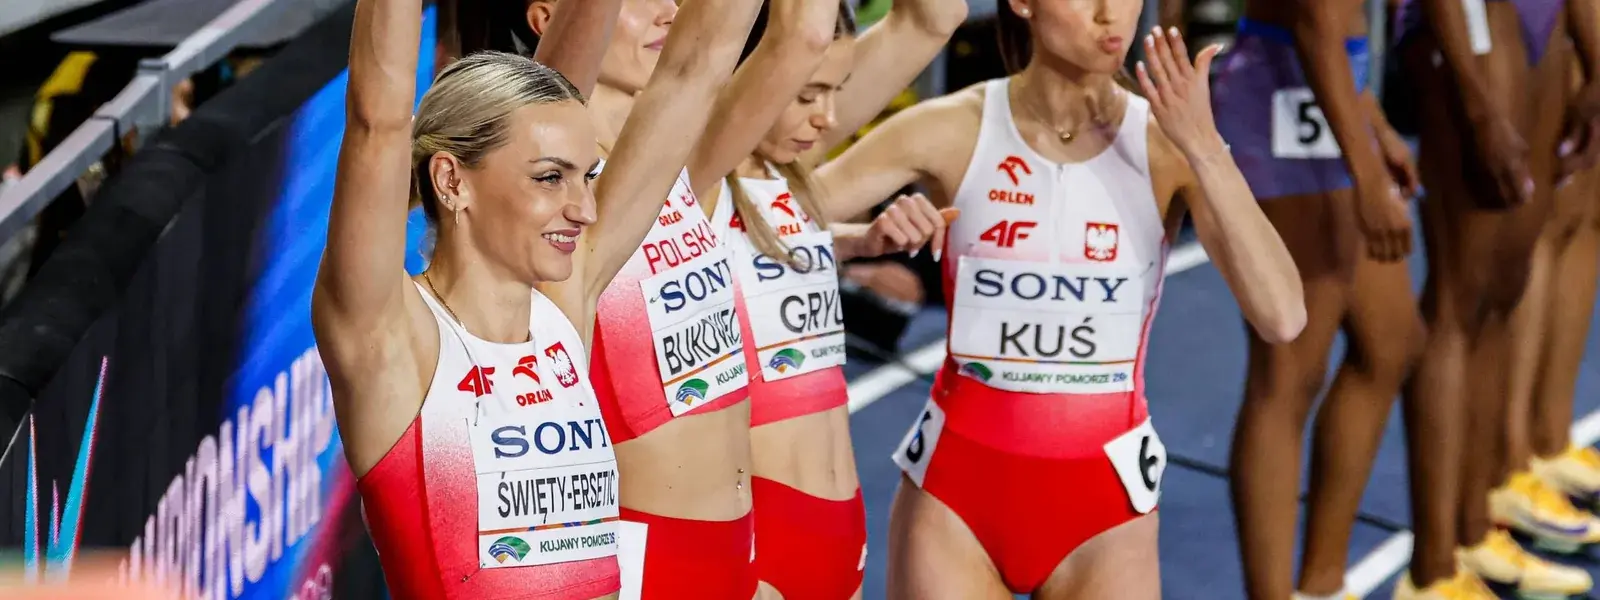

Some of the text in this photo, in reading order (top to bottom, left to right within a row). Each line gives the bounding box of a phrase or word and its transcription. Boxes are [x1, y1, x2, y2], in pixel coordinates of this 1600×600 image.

[1298, 102, 1321, 143] 5
[988, 189, 1034, 206] ORLEN
[642, 219, 717, 275] POLSKA
[980, 219, 1038, 248] 4F
[973, 269, 1128, 302] SONY
[1000, 316, 1097, 358] KUŚ
[457, 365, 495, 397] 4F
[1002, 371, 1052, 383] KUJAWY
[1056, 373, 1109, 384] POMORZE
[1138, 436, 1159, 492] 6
[498, 469, 616, 524] ŚWIĘTY-ERSETIC
[539, 537, 579, 553] KUJAWY
